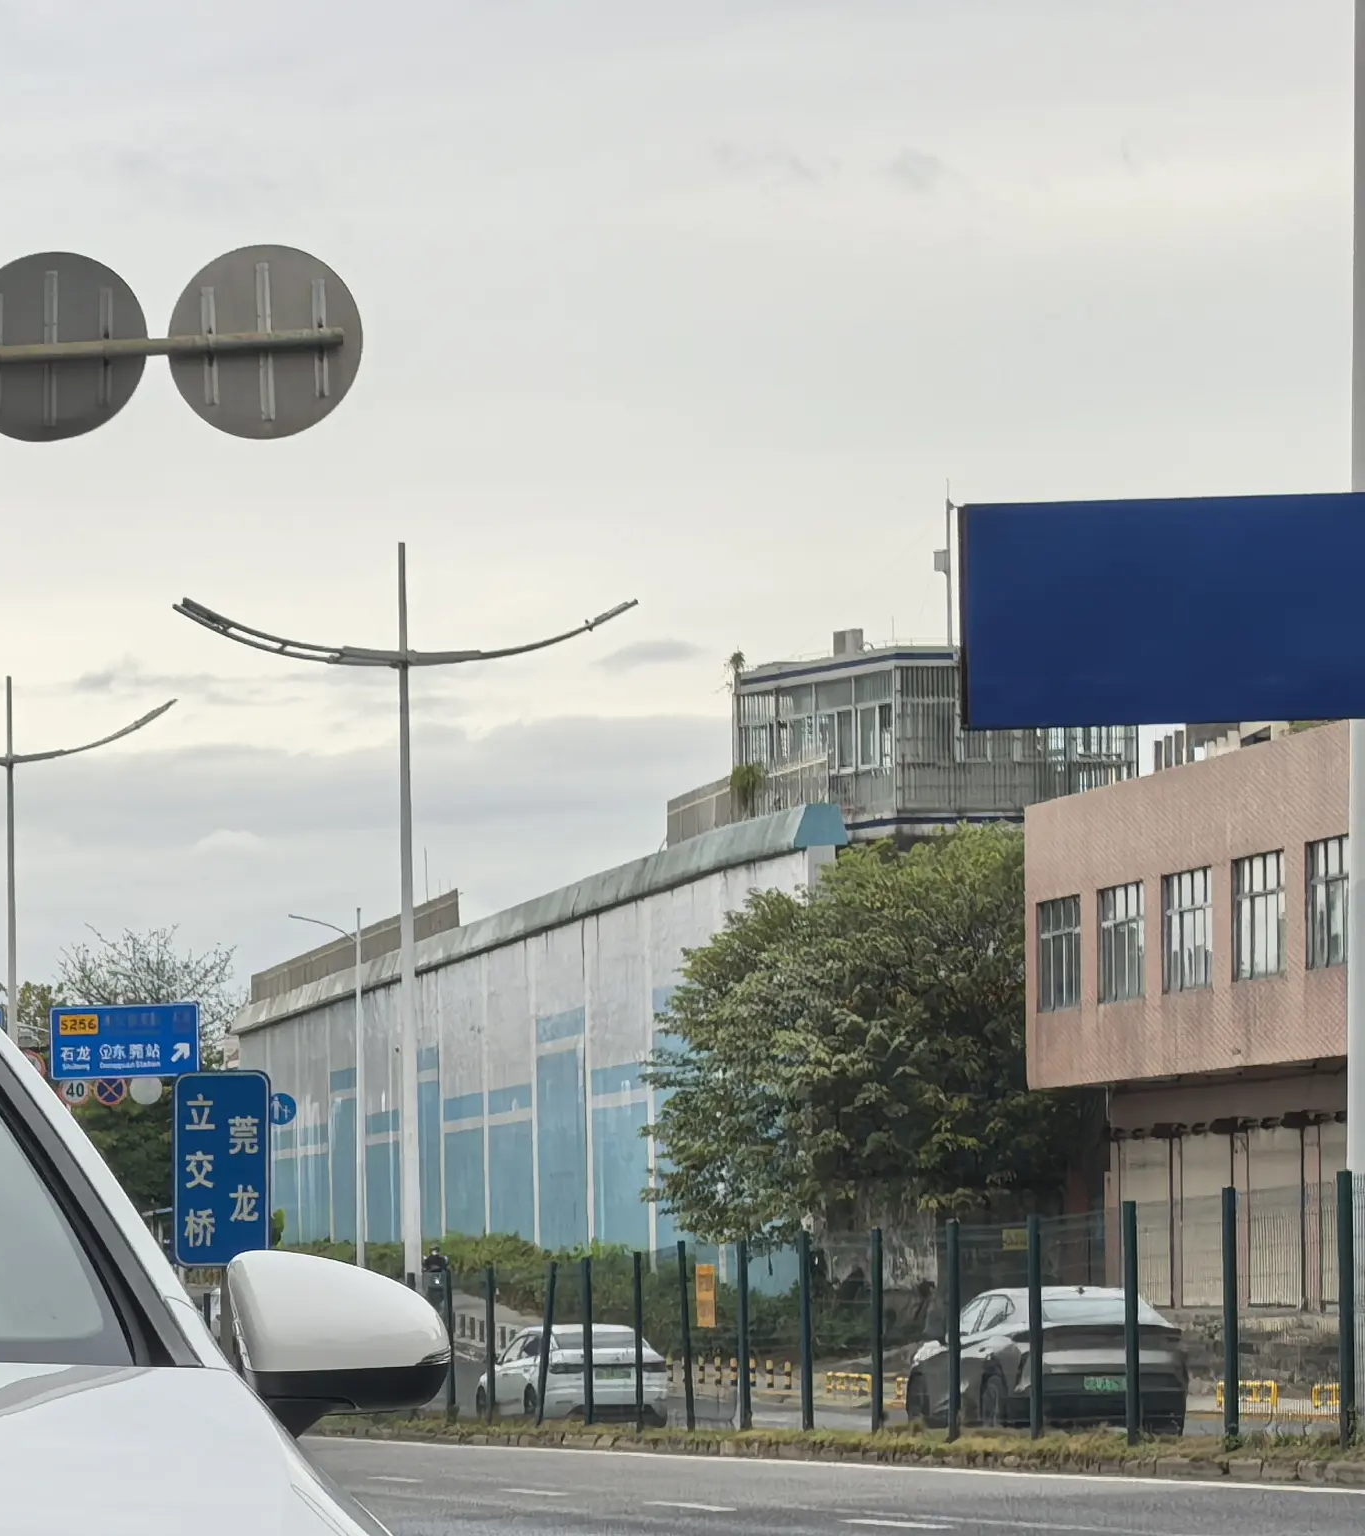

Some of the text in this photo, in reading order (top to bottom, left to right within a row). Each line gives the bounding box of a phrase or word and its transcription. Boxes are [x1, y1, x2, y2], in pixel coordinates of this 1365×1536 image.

[60, 1018, 98, 1032] S256
[60, 1046, 92, 1062] 石龙
[66, 1082, 85, 1098] 40
